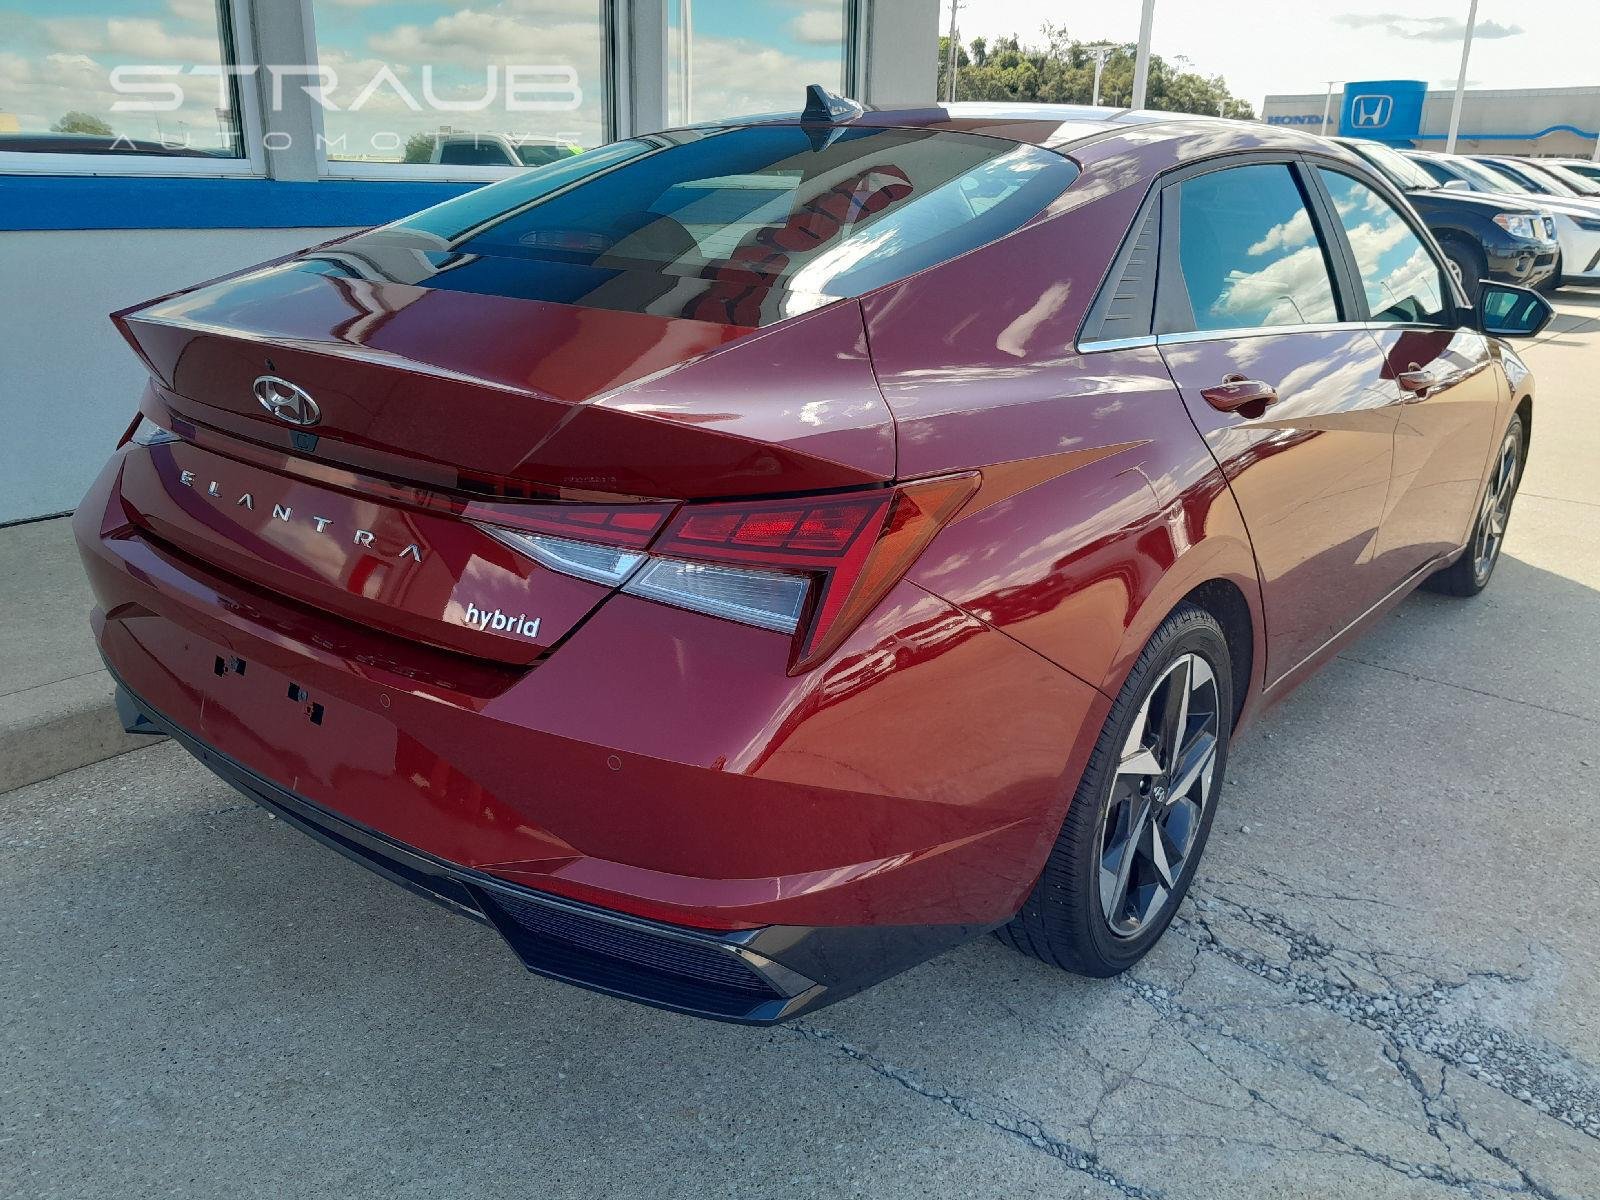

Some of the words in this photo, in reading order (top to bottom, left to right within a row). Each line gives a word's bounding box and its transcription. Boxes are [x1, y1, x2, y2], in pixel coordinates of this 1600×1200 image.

[1267, 114, 1334, 124] HONDA
[179, 469, 423, 563] ELANTRA
[464, 603, 542, 639] hybrid
